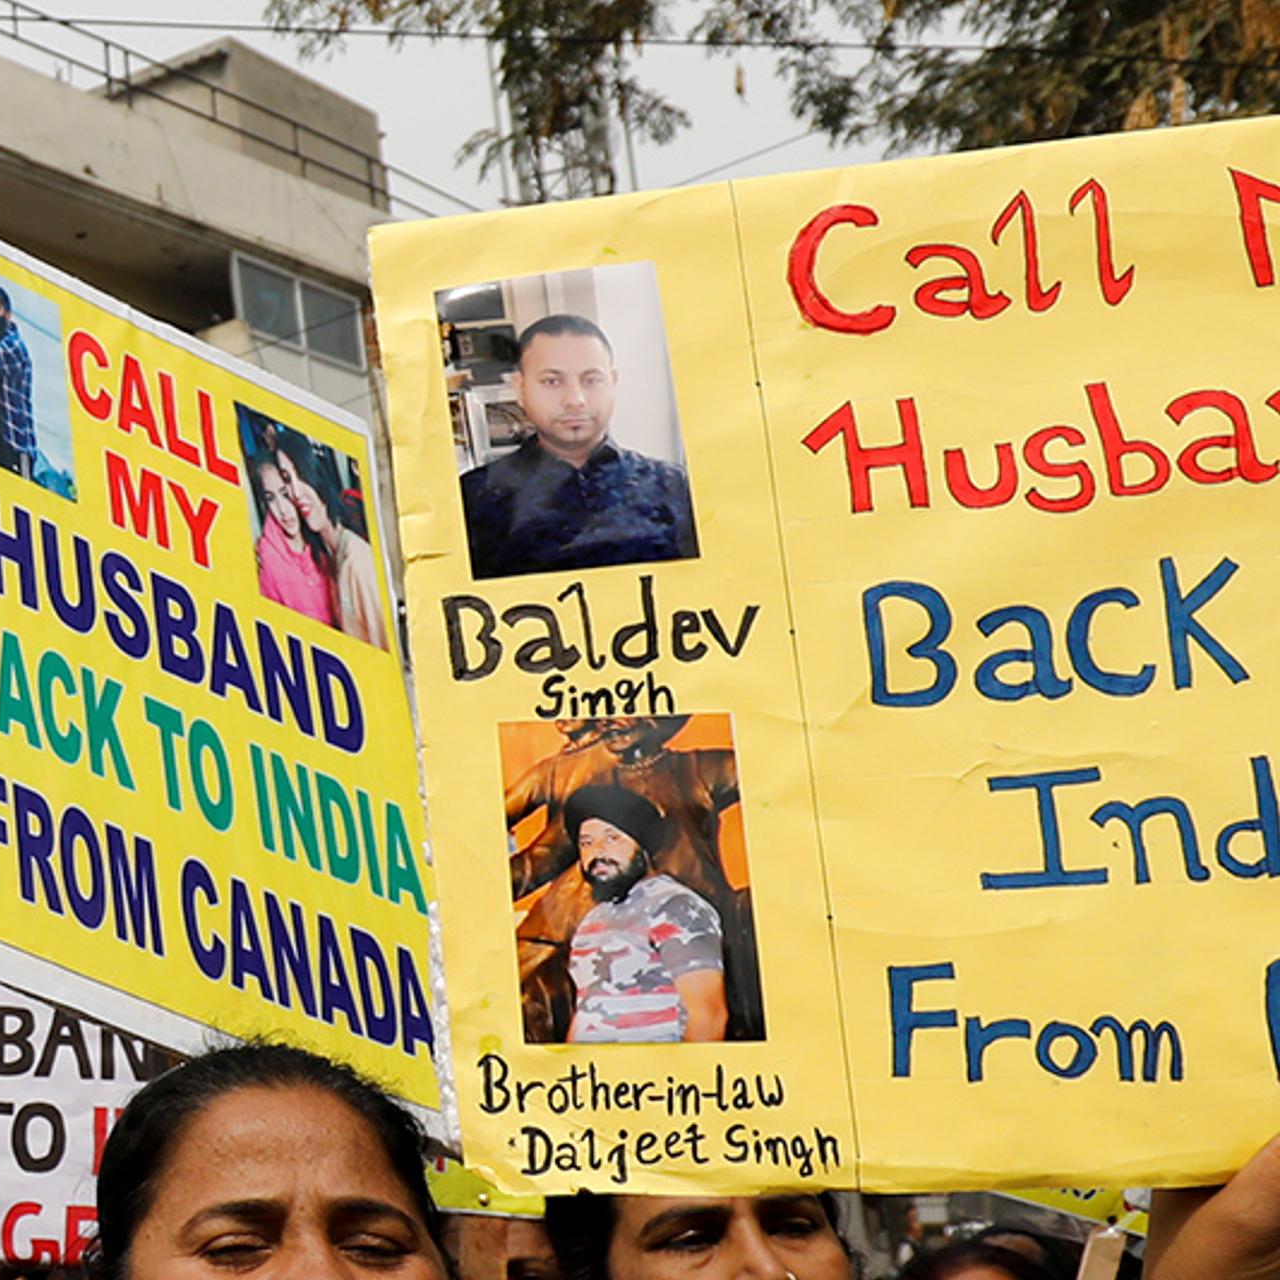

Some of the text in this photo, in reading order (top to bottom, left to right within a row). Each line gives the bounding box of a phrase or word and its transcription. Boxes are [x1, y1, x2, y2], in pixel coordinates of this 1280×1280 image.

[786, 178, 1135, 336] Call
[67, 330, 240, 487] CALL
[801, 382, 1280, 513] Husba
[105, 449, 220, 569] MY
[442, 575, 760, 681] Baldev
[536, 671, 675, 718] Singh
[143, 696, 234, 833] TO
[249, 741, 429, 916] INDIA
[181, 858, 436, 1058] CANADA
[887, 961, 1184, 1082] From
[477, 1053, 784, 1114] Brother-in-law
[521, 1124, 841, 1184] Daljeet Singh
